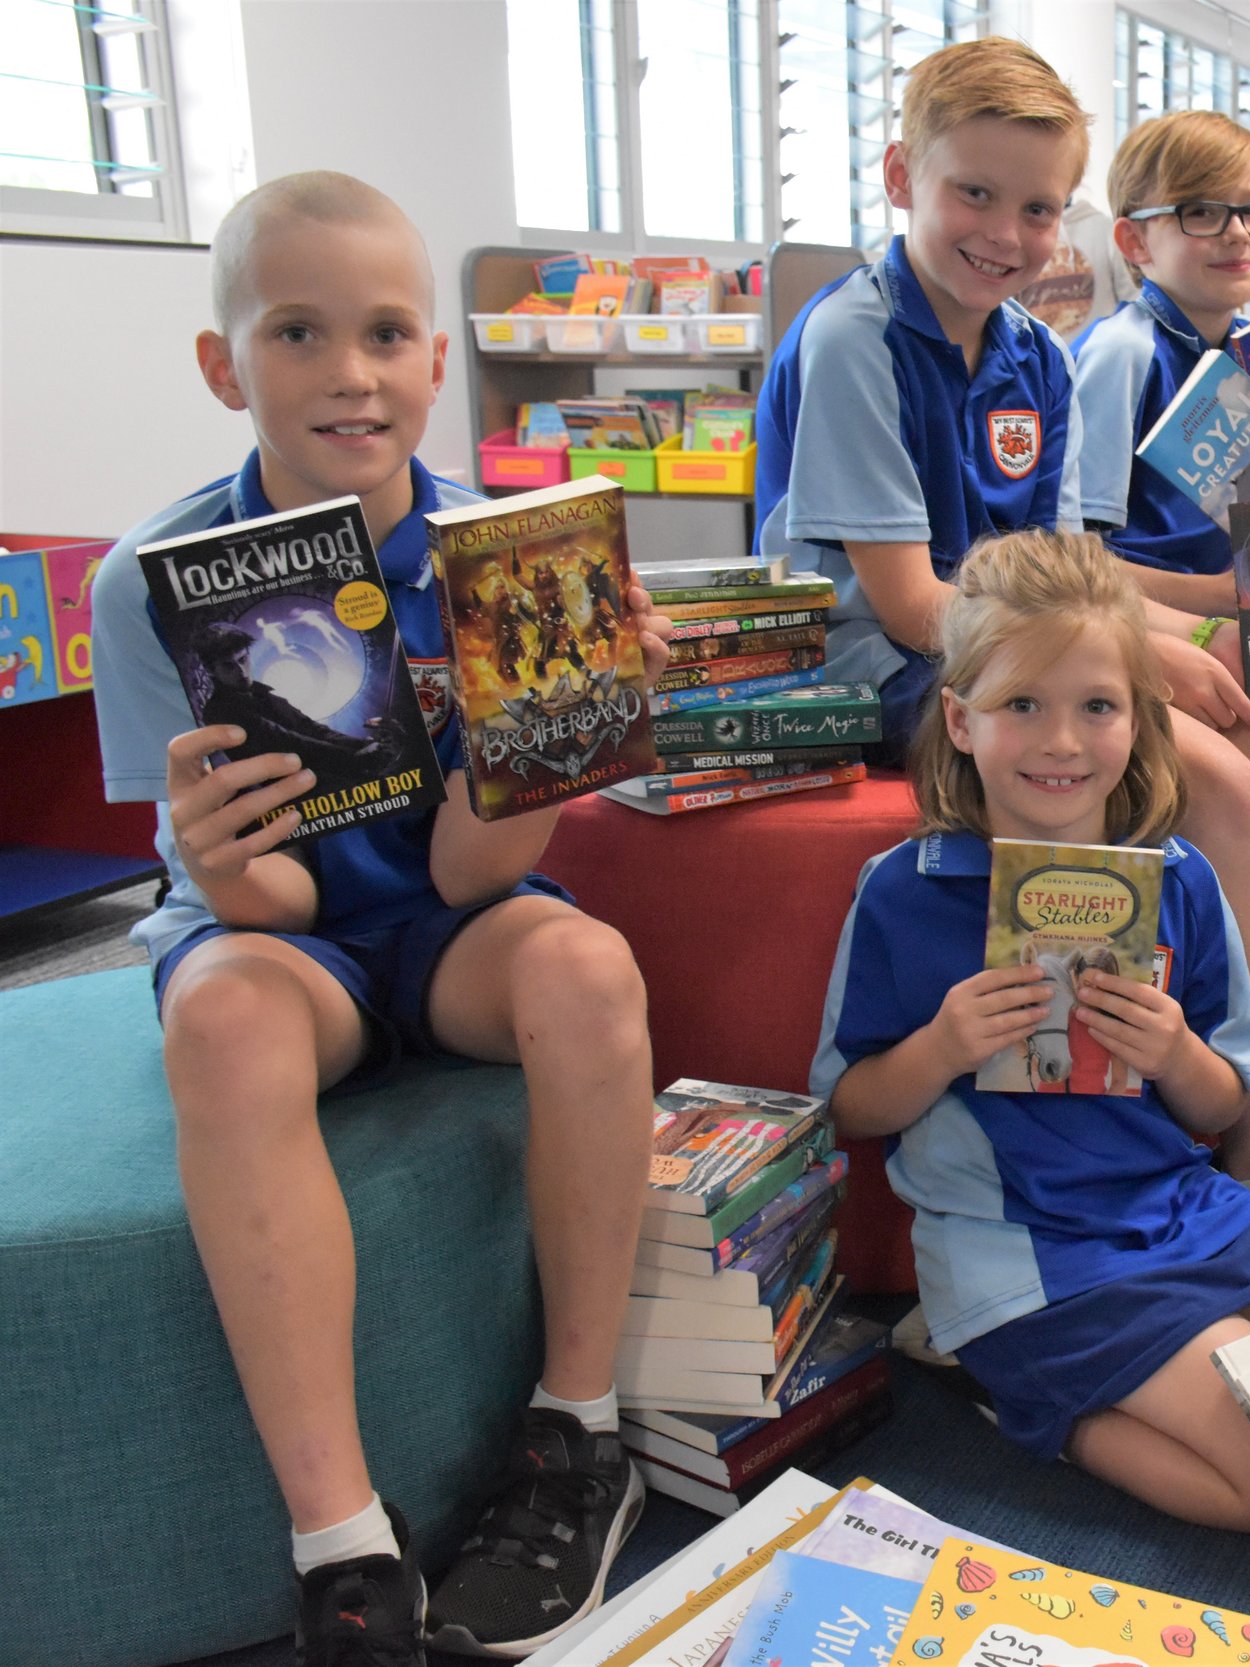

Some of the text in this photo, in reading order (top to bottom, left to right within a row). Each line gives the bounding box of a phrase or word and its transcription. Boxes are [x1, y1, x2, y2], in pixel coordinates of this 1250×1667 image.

[1181, 396, 1210, 428] morris
[1183, 396, 1220, 443] gleitzman
[453, 523, 511, 554] JOHN
[517, 496, 617, 535] FLANAGAN
[211, 588, 251, 604] Hauntings
[252, 585, 265, 594] are
[266, 582, 278, 591] our
[754, 616, 777, 629] MICK
[779, 612, 811, 626] ELLIOTT
[661, 671, 689, 681] RESSIDA
[722, 656, 789, 678] DRAGON
[655, 680, 690, 692] COWELL
[481, 687, 641, 772] BROTHERBAND
[654, 721, 704, 731] CRESSIDA
[773, 713, 859, 737] Twice Magic
[654, 733, 704, 744] COWELL
[693, 753, 774, 768] MEDICAL MISSION
[301, 780, 382, 820] HOLLOW
[386, 768, 424, 795] BOY
[515, 760, 628, 805] THE INVADERS
[358, 794, 410, 818] STROUD
[1042, 877, 1113, 888] SORAYA NICHOLAS
[1023, 891, 1128, 911] STARLIGHT
[1035, 902, 1115, 931] Stables
[1032, 932, 1075, 941] GYMKHANA
[790, 1376, 826, 1405] Zafir
[843, 1514, 917, 1551] The Girl
[687, 1534, 796, 1615] ANNIVERSARY EDITION
[668, 1604, 752, 1667] JAPANES
[750, 1590, 793, 1665] the Bush Mob
